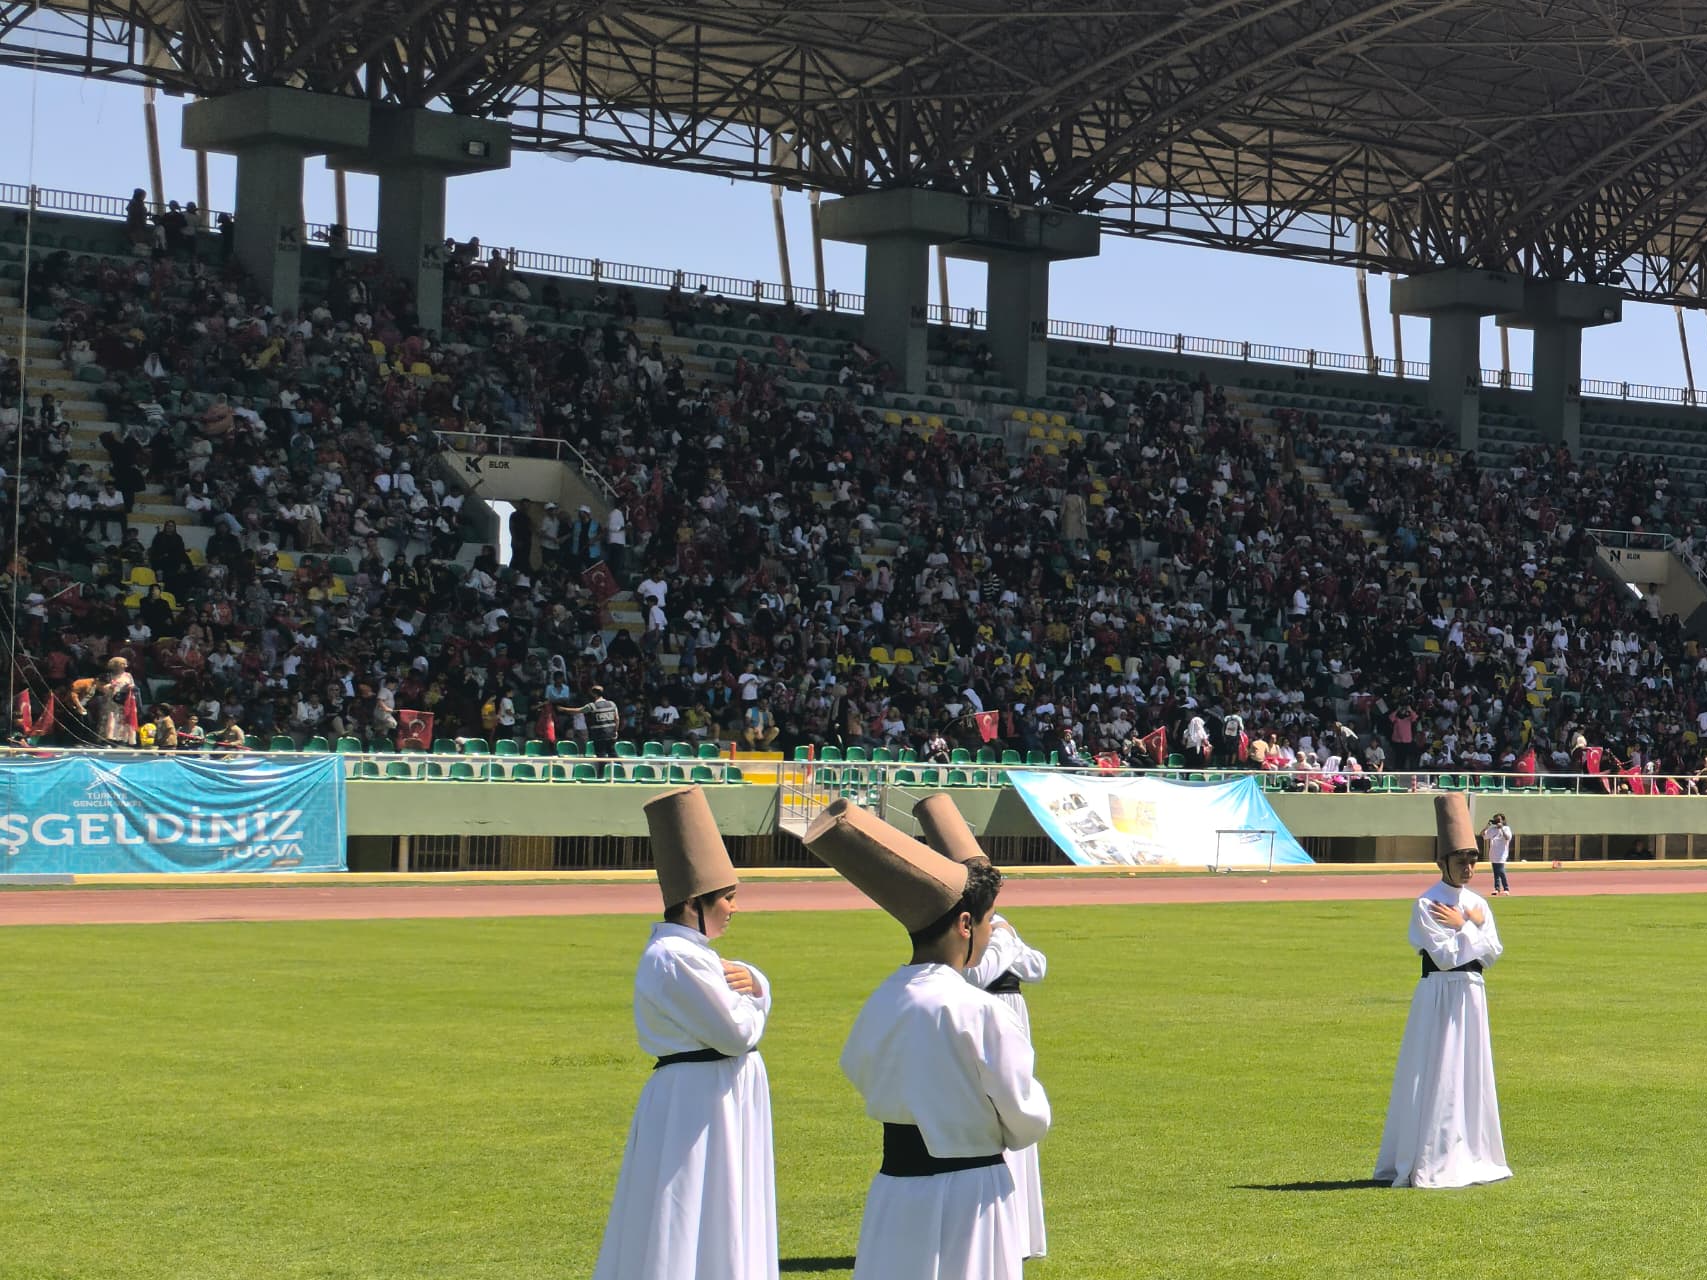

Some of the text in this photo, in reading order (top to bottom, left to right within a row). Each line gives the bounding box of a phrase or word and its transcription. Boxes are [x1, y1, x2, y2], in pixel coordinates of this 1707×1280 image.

[280, 225, 297, 242] K
[424, 244, 440, 259] K
[465, 456, 510, 473] K BLOK
[1609, 550, 1621, 561] N
